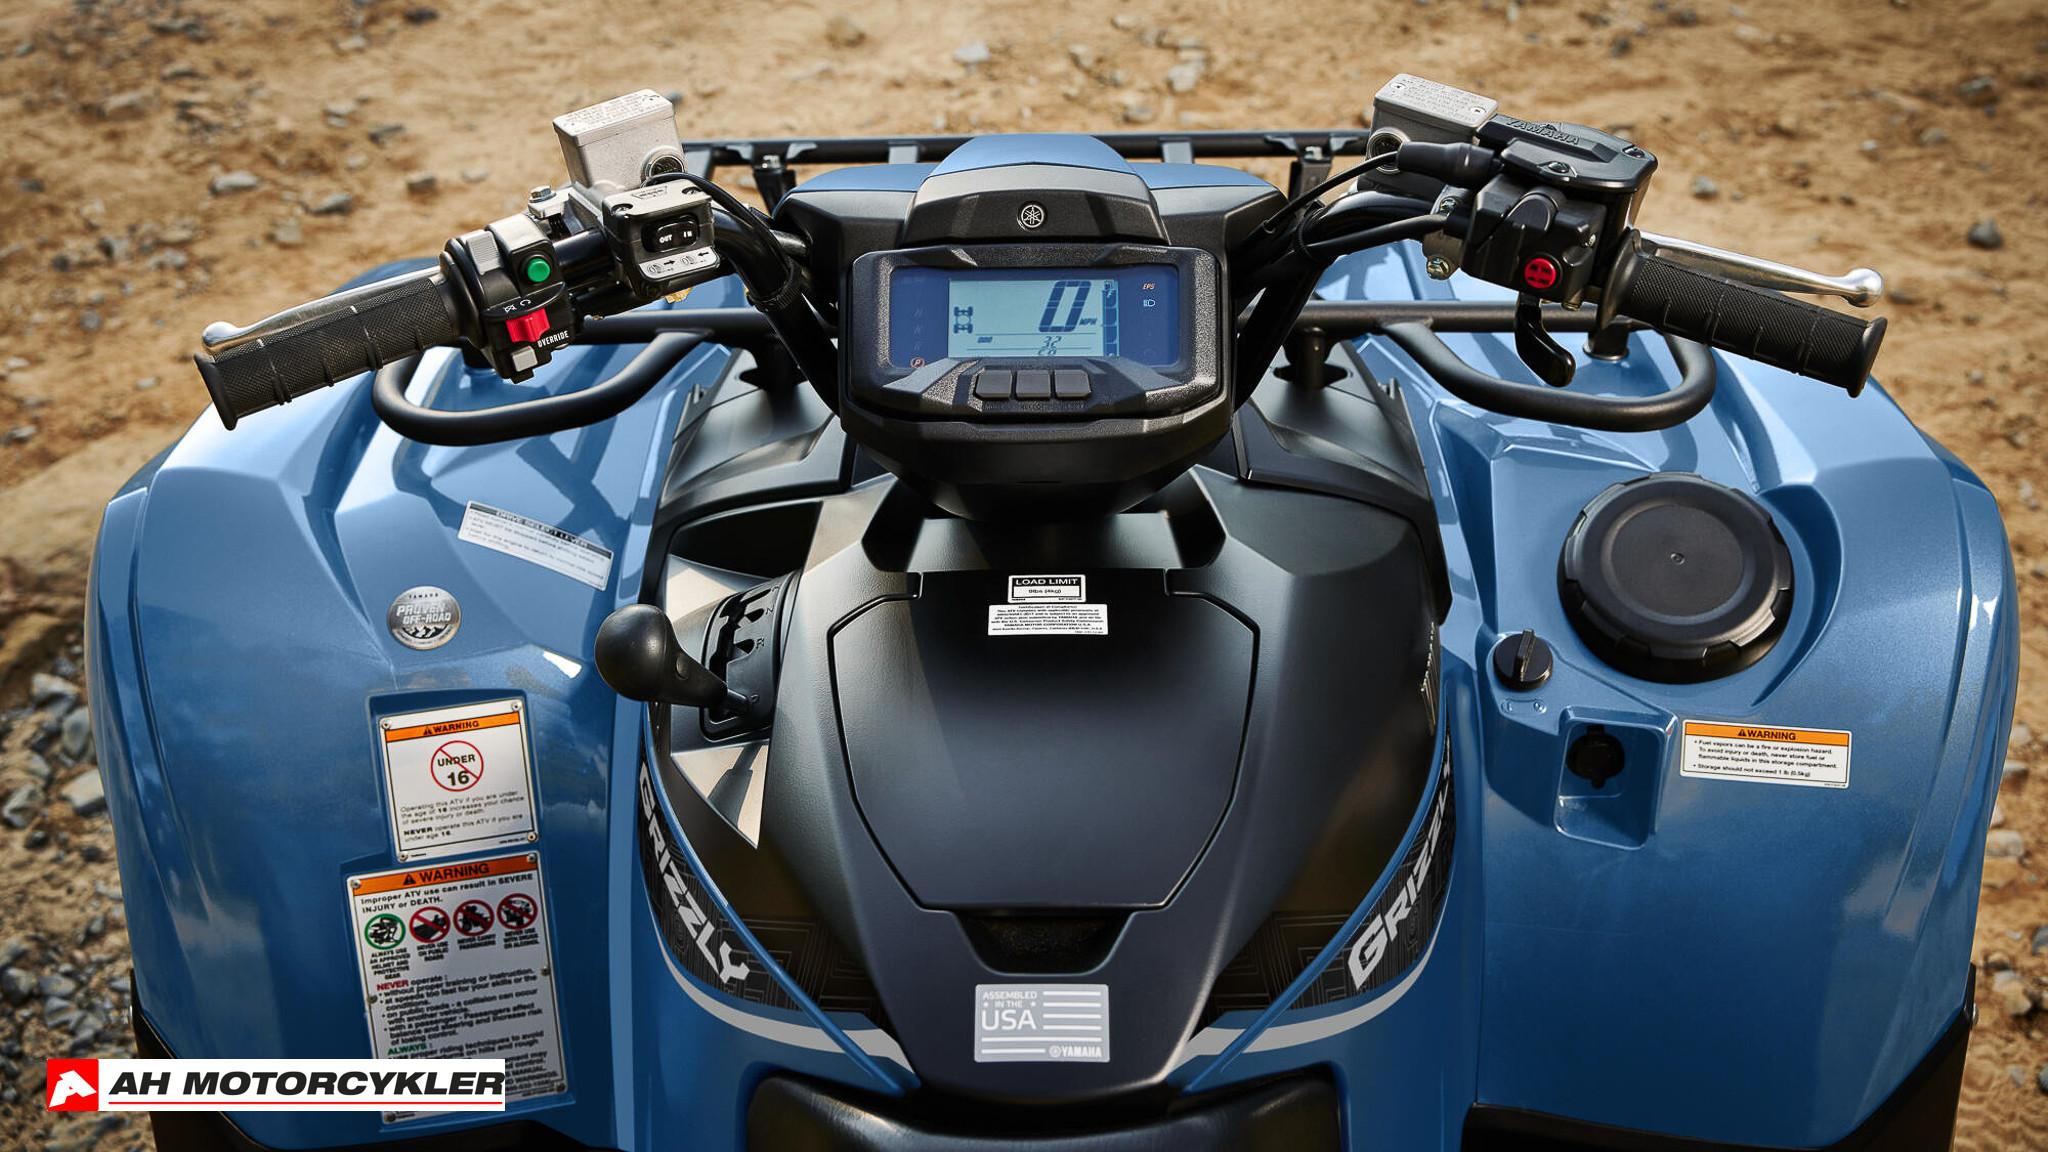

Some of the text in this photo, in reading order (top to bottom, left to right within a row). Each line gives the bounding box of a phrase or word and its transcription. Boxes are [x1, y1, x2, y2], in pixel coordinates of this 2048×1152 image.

[1505, 118, 1579, 145] YAMAHA
[659, 234, 673, 244] OUT
[1142, 282, 1155, 290] EPS
[1038, 280, 1091, 332] 0
[537, 330, 569, 347] OVERRIDE
[402, 612, 452, 625] OFF-ROAD
[433, 720, 479, 733] WARNING
[1748, 730, 1796, 740] WARNING
[1781, 745, 1808, 753] explosion
[438, 754, 475, 767] UNDER
[448, 770, 469, 786] 16
[401, 803, 433, 813] Operating
[450, 803, 481, 811] increases
[500, 796, 524, 804] chance
[404, 827, 432, 835] NEVER
[435, 823, 460, 832] operate
[1348, 733, 1450, 990] GRIZZLY
[420, 863, 488, 883] WARNING
[639, 761, 750, 984] GRIZZLY
[361, 894, 401, 905] Improper
[460, 881, 485, 890] result
[499, 873, 532, 884] SEVERE
[363, 904, 395, 913] INJURY
[410, 896, 442, 906] DEATH.
[380, 953, 410, 962] APPROVED
[374, 966, 409, 975] PROTECTIVE
[377, 975, 442, 991] NEVER operate
[384, 987, 413, 997] without
[417, 983, 444, 993] proper
[446, 977, 477, 988] training
[489, 967, 534, 980] instruction.
[395, 993, 424, 1004] speeds
[441, 987, 456, 995] fast
[471, 983, 490, 991] your
[492, 979, 511, 987] skills
[983, 991, 1037, 1000] ASSEMBLED
[386, 999, 430, 1011] conditions.
[400, 1007, 424, 1017] public
[426, 1003, 449, 1011] roads
[463, 995, 496, 1005] collision
[515, 989, 537, 997] occur
[994, 1000, 1023, 1008] IN THE
[388, 1007, 468, 1025] with another vehicle.
[415, 1017, 456, 1029] passenger
[464, 1007, 510, 1020] Passengers
[981, 1009, 1037, 1031] USA
[390, 1029, 421, 1038] balance
[442, 1020, 473, 1031] steering
[493, 1011, 525, 1021] increase
[402, 1035, 426, 1045] losing
[428, 1029, 457, 1039] control.
[440, 1044, 463, 1054] riding
[465, 1037, 509, 1049] techniques
[522, 1031, 544, 1039] avoid
[515, 1039, 538, 1049] rough
[388, 1043, 427, 1055] ALWAYS
[1062, 1046, 1102, 1057] YAMAHA
